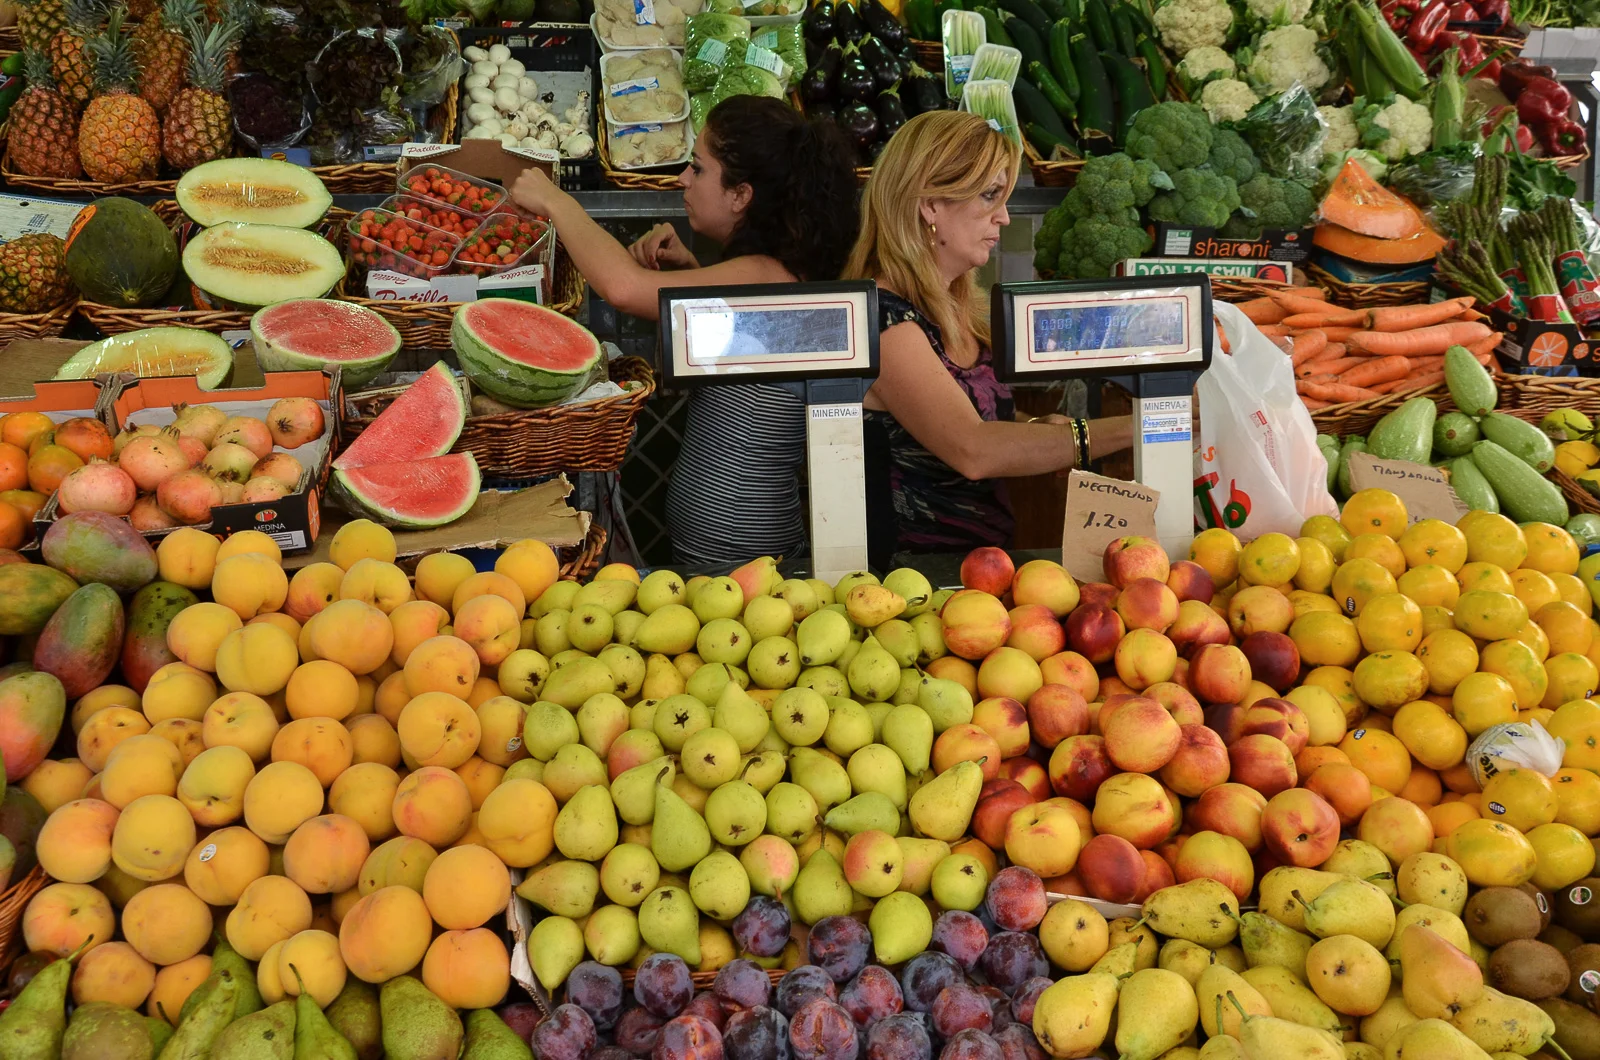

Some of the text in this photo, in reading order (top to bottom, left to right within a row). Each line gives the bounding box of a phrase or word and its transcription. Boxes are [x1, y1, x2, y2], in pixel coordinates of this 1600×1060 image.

[1194, 238, 1269, 257] sharoni
[1144, 401, 1181, 411] MINERVA
[812, 408, 851, 418] MINERVA
[1083, 511, 1128, 529] 1.20
[254, 523, 286, 533] MEDINA
[1489, 802, 1506, 813] elite
